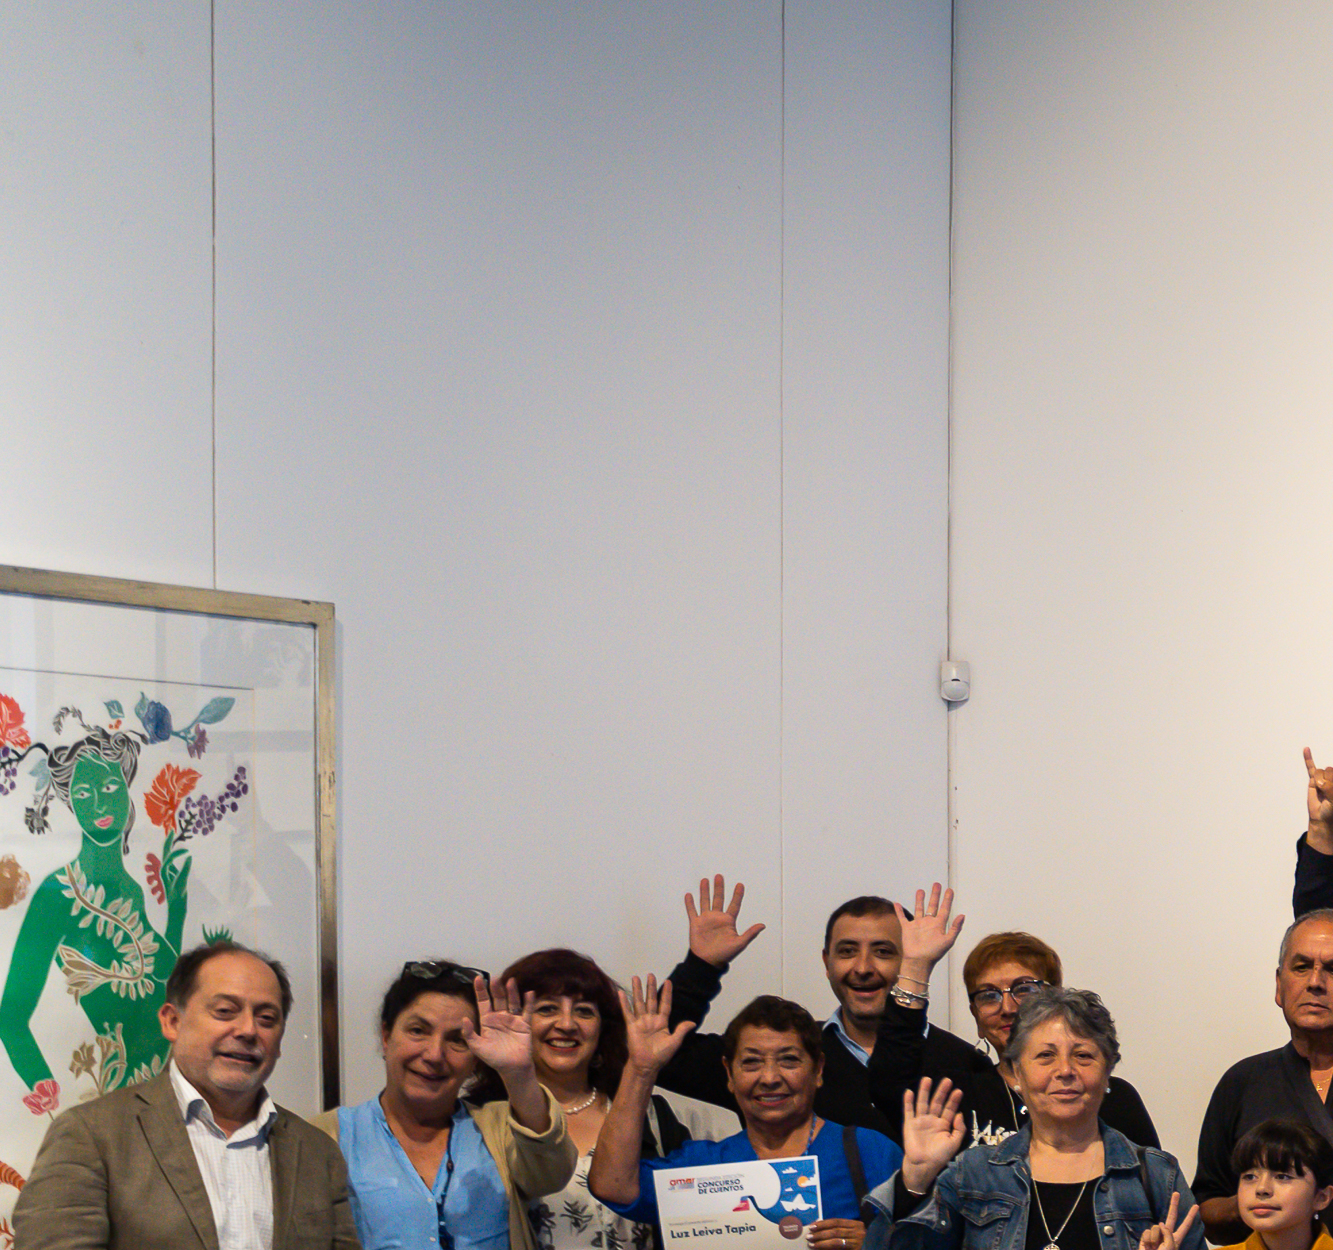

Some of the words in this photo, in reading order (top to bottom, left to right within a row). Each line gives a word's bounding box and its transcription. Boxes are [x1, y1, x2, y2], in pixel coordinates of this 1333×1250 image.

[697, 1178, 741, 1189] CONCURSO
[698, 1187, 708, 1195] DE
[709, 1185, 744, 1194] CUENTOS
[670, 1229, 690, 1239] Luz
[693, 1227, 723, 1237] Leiva
[725, 1223, 757, 1235] Tapia
